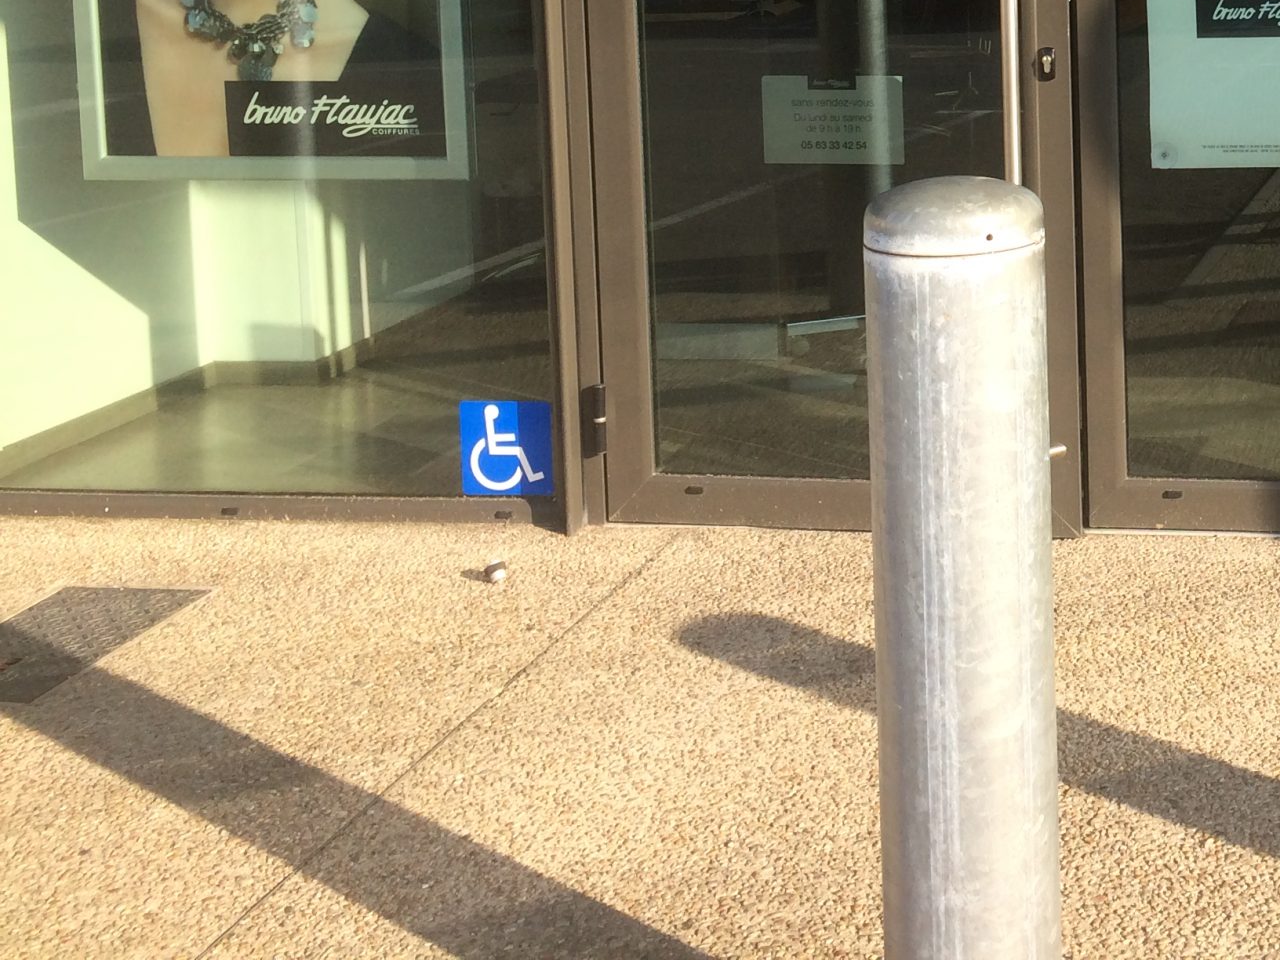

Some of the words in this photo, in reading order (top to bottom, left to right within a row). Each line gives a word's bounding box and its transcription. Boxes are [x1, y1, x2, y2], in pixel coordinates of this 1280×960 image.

[1212, 0, 1256, 21] bruno
[243, 91, 307, 125] bruno
[371, 128, 420, 136] COIFFURES
[801, 140, 813, 150] 05
[815, 140, 828, 150] 63
[829, 140, 841, 150] 33
[842, 140, 854, 150] 42
